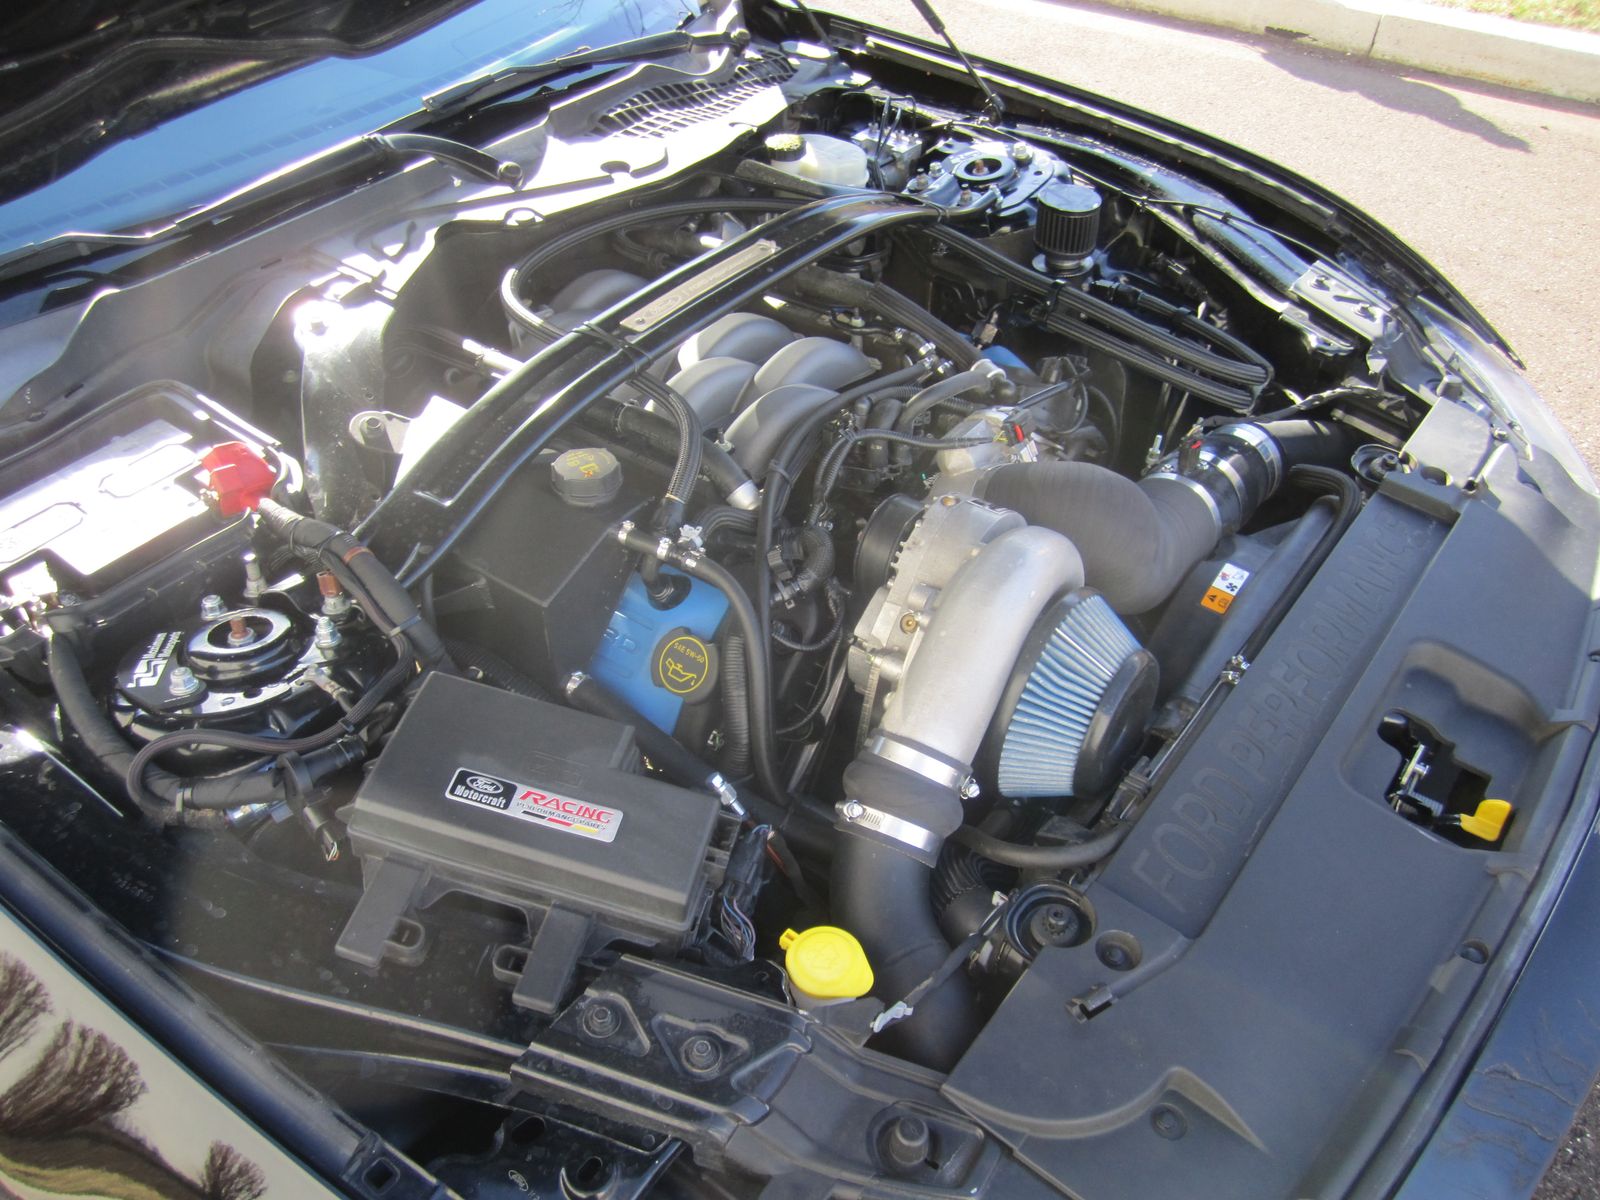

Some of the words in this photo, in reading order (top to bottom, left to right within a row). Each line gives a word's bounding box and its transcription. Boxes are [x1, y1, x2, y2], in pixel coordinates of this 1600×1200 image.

[1130, 766, 1253, 914] FORD
[1218, 512, 1433, 782] PERFORMANCE
[454, 784, 506, 809] Motorcraft
[470, 777, 498, 793] Ford
[519, 790, 615, 824] RACING
